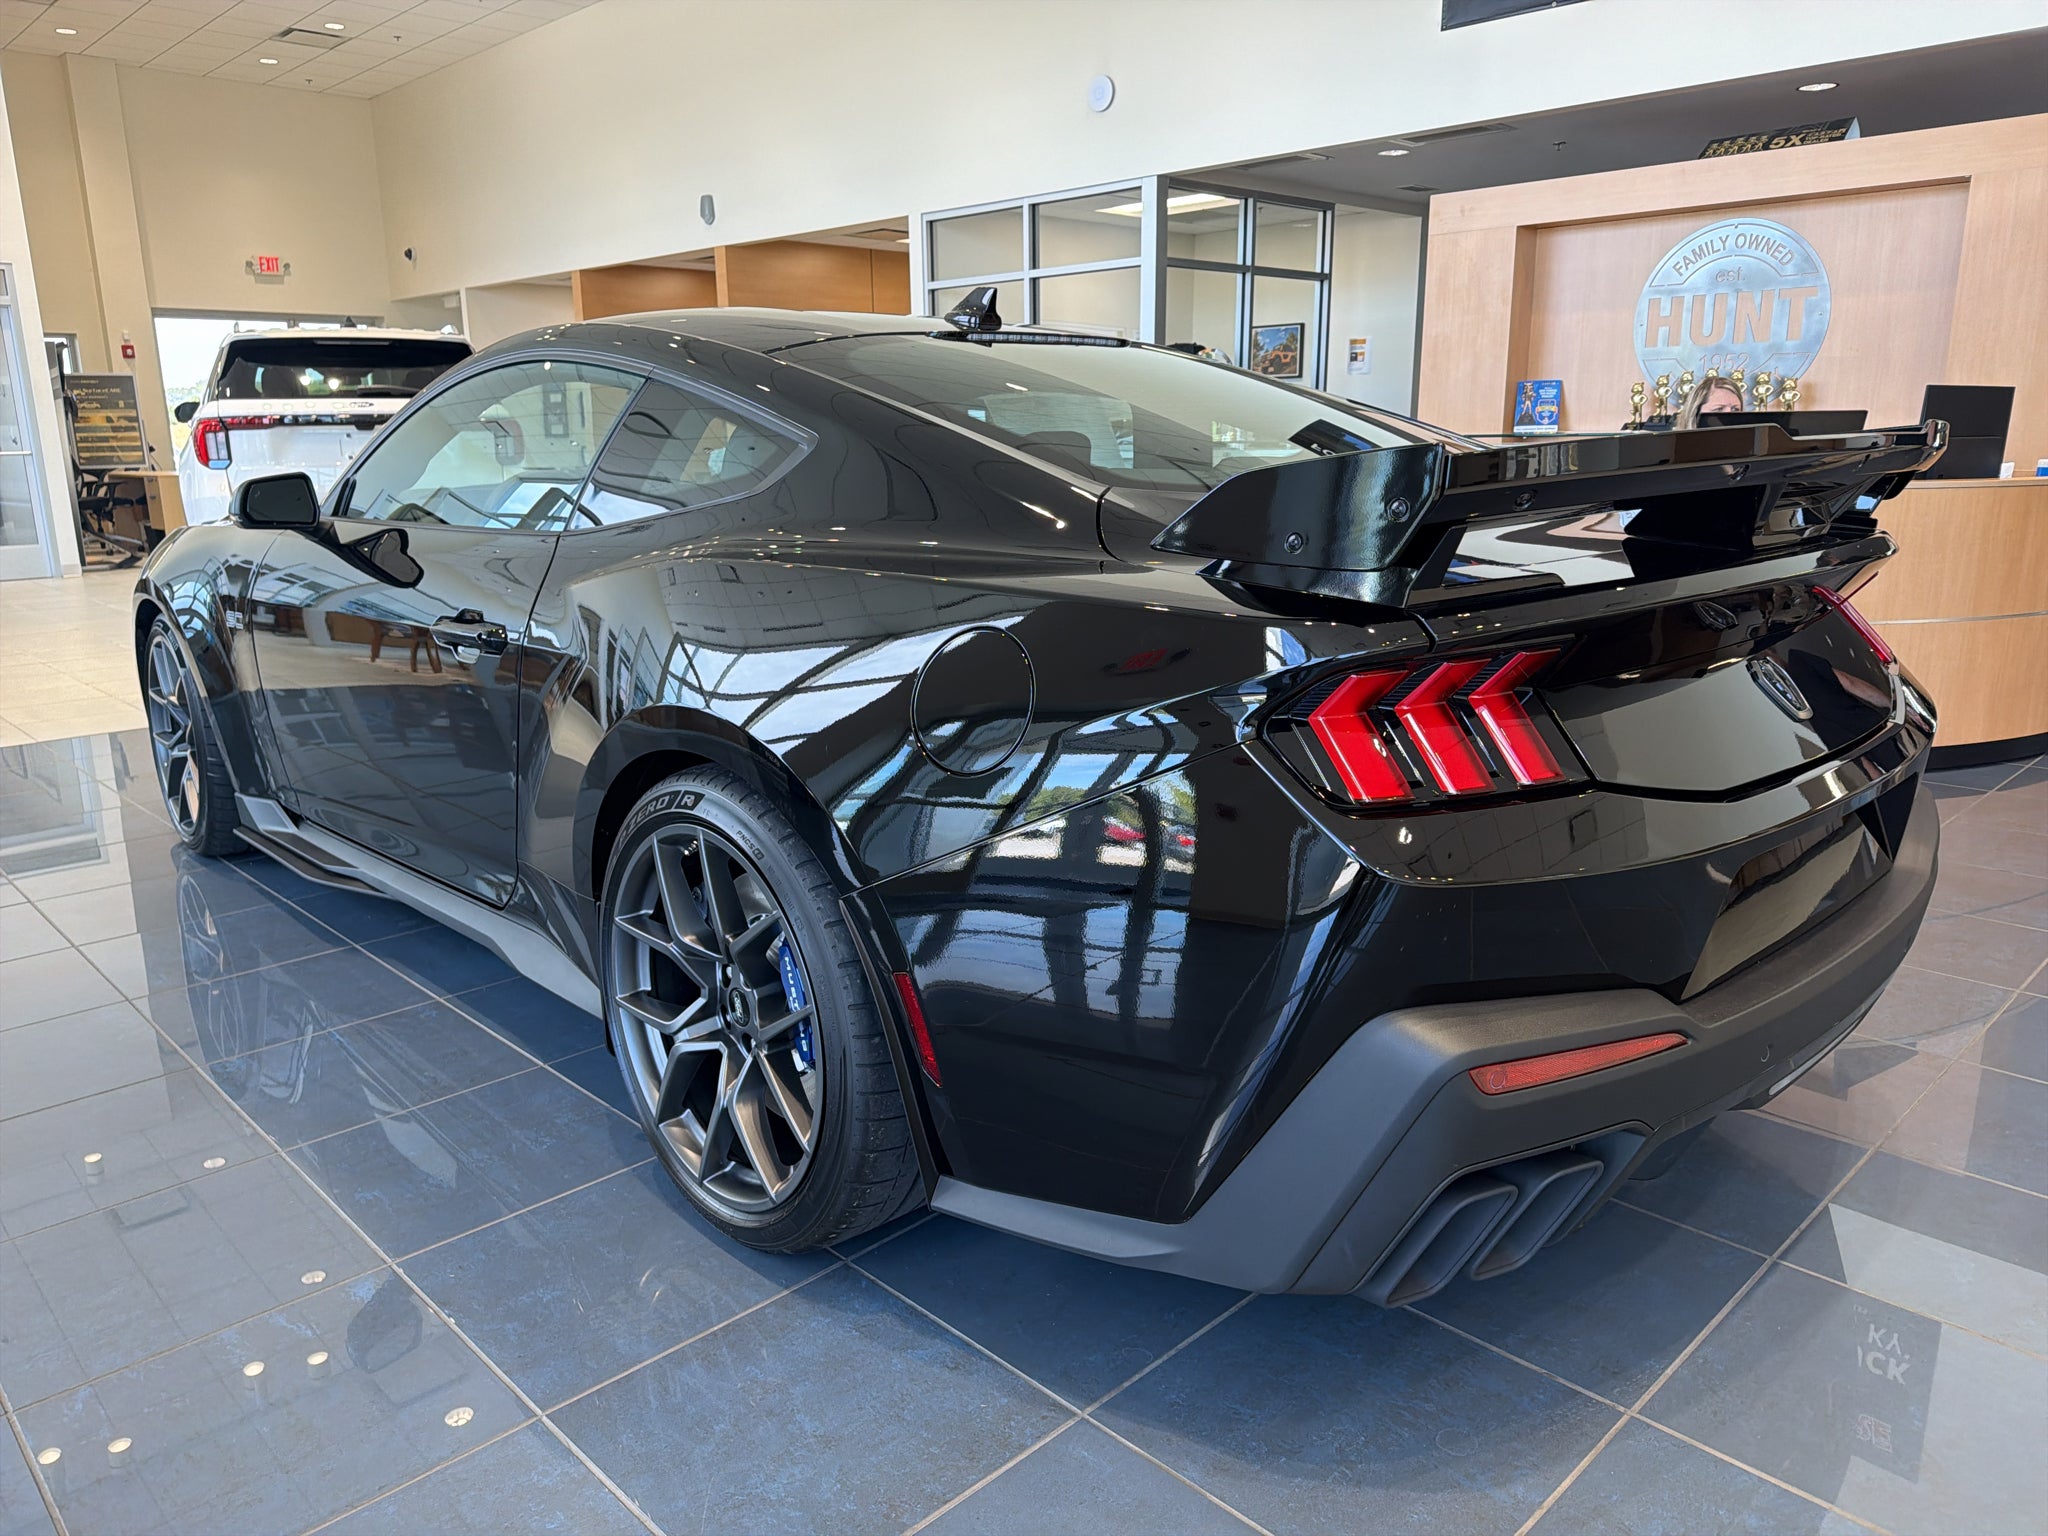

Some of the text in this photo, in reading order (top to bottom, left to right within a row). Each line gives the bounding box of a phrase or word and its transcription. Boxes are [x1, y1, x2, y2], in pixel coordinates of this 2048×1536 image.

[1768, 133, 1806, 149] 5X
[259, 255, 279, 272] EXIT
[1672, 232, 1796, 277] FAMILY OWNED
[1644, 285, 1820, 349] HUNT
[1699, 352, 1750, 372] 1952
[680, 794, 697, 807] R
[627, 795, 671, 834] ZERO
[735, 830, 756, 850] PNCS
[784, 956, 809, 1052] MUSTNG
